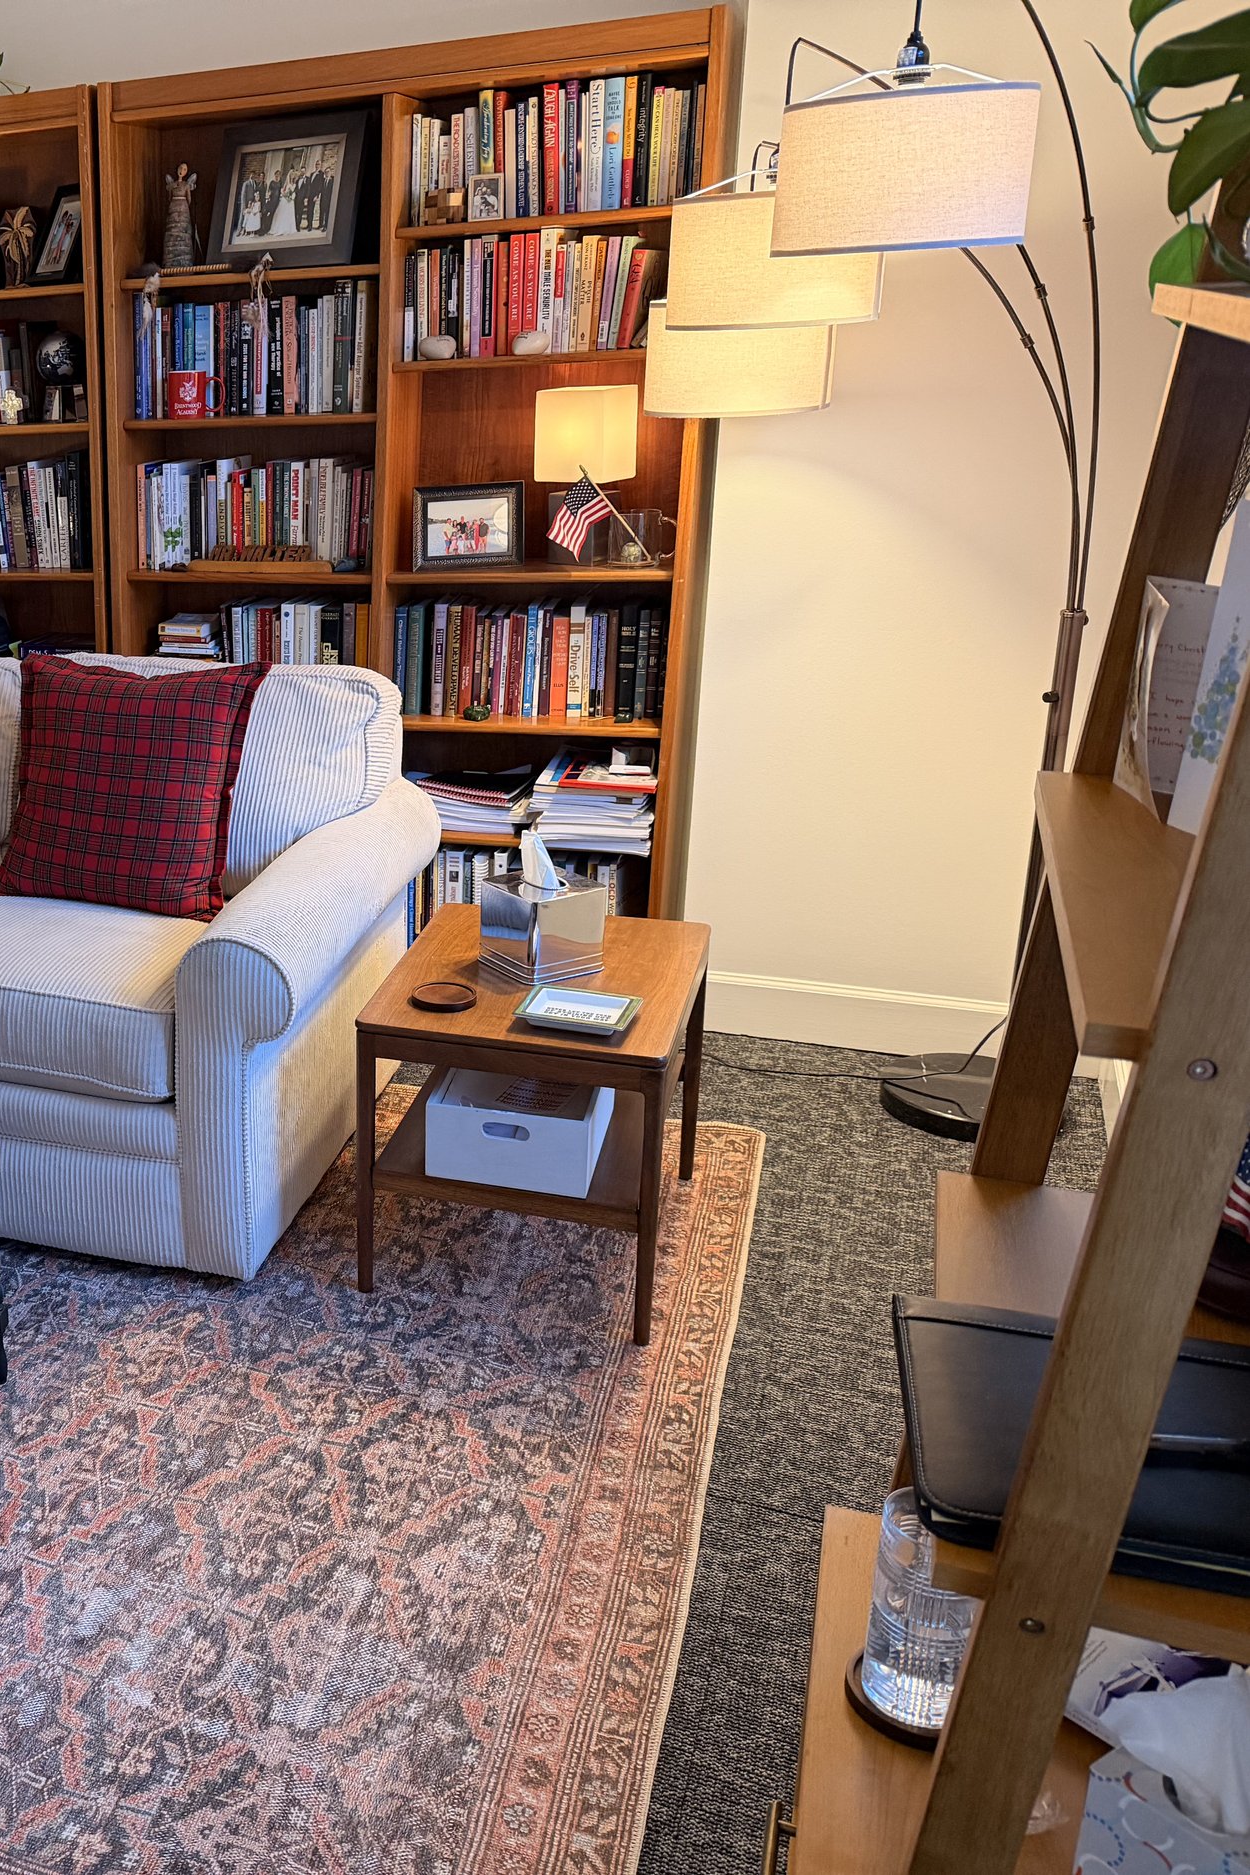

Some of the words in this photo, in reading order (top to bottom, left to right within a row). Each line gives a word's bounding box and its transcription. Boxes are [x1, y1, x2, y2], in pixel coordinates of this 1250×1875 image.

[544, 89, 556, 117] LAUGH
[591, 84, 602, 114] Start
[482, 103, 490, 142] Awakening
[545, 119, 557, 147] AGAIN
[591, 119, 601, 148] Here
[636, 107, 648, 143] integrity
[466, 133, 474, 149] Self
[481, 143, 489, 158] Joy
[452, 160, 460, 188] TRAVELE
[607, 167, 615, 199] Gottlieb
[512, 269, 518, 280] AS
[527, 268, 534, 279] AS
[543, 272, 551, 287] MALE
[542, 289, 550, 320] SEXUALITY
[355, 355, 363, 375] Asperger
[30, 476, 38, 500] INFINITE
[527, 626, 535, 655] GROUPS
[570, 645, 580, 671] Drive
[449, 647, 460, 712] DEVELOPMENT
[570, 675, 579, 693] Self
[1166, 694, 1184, 705] hope
